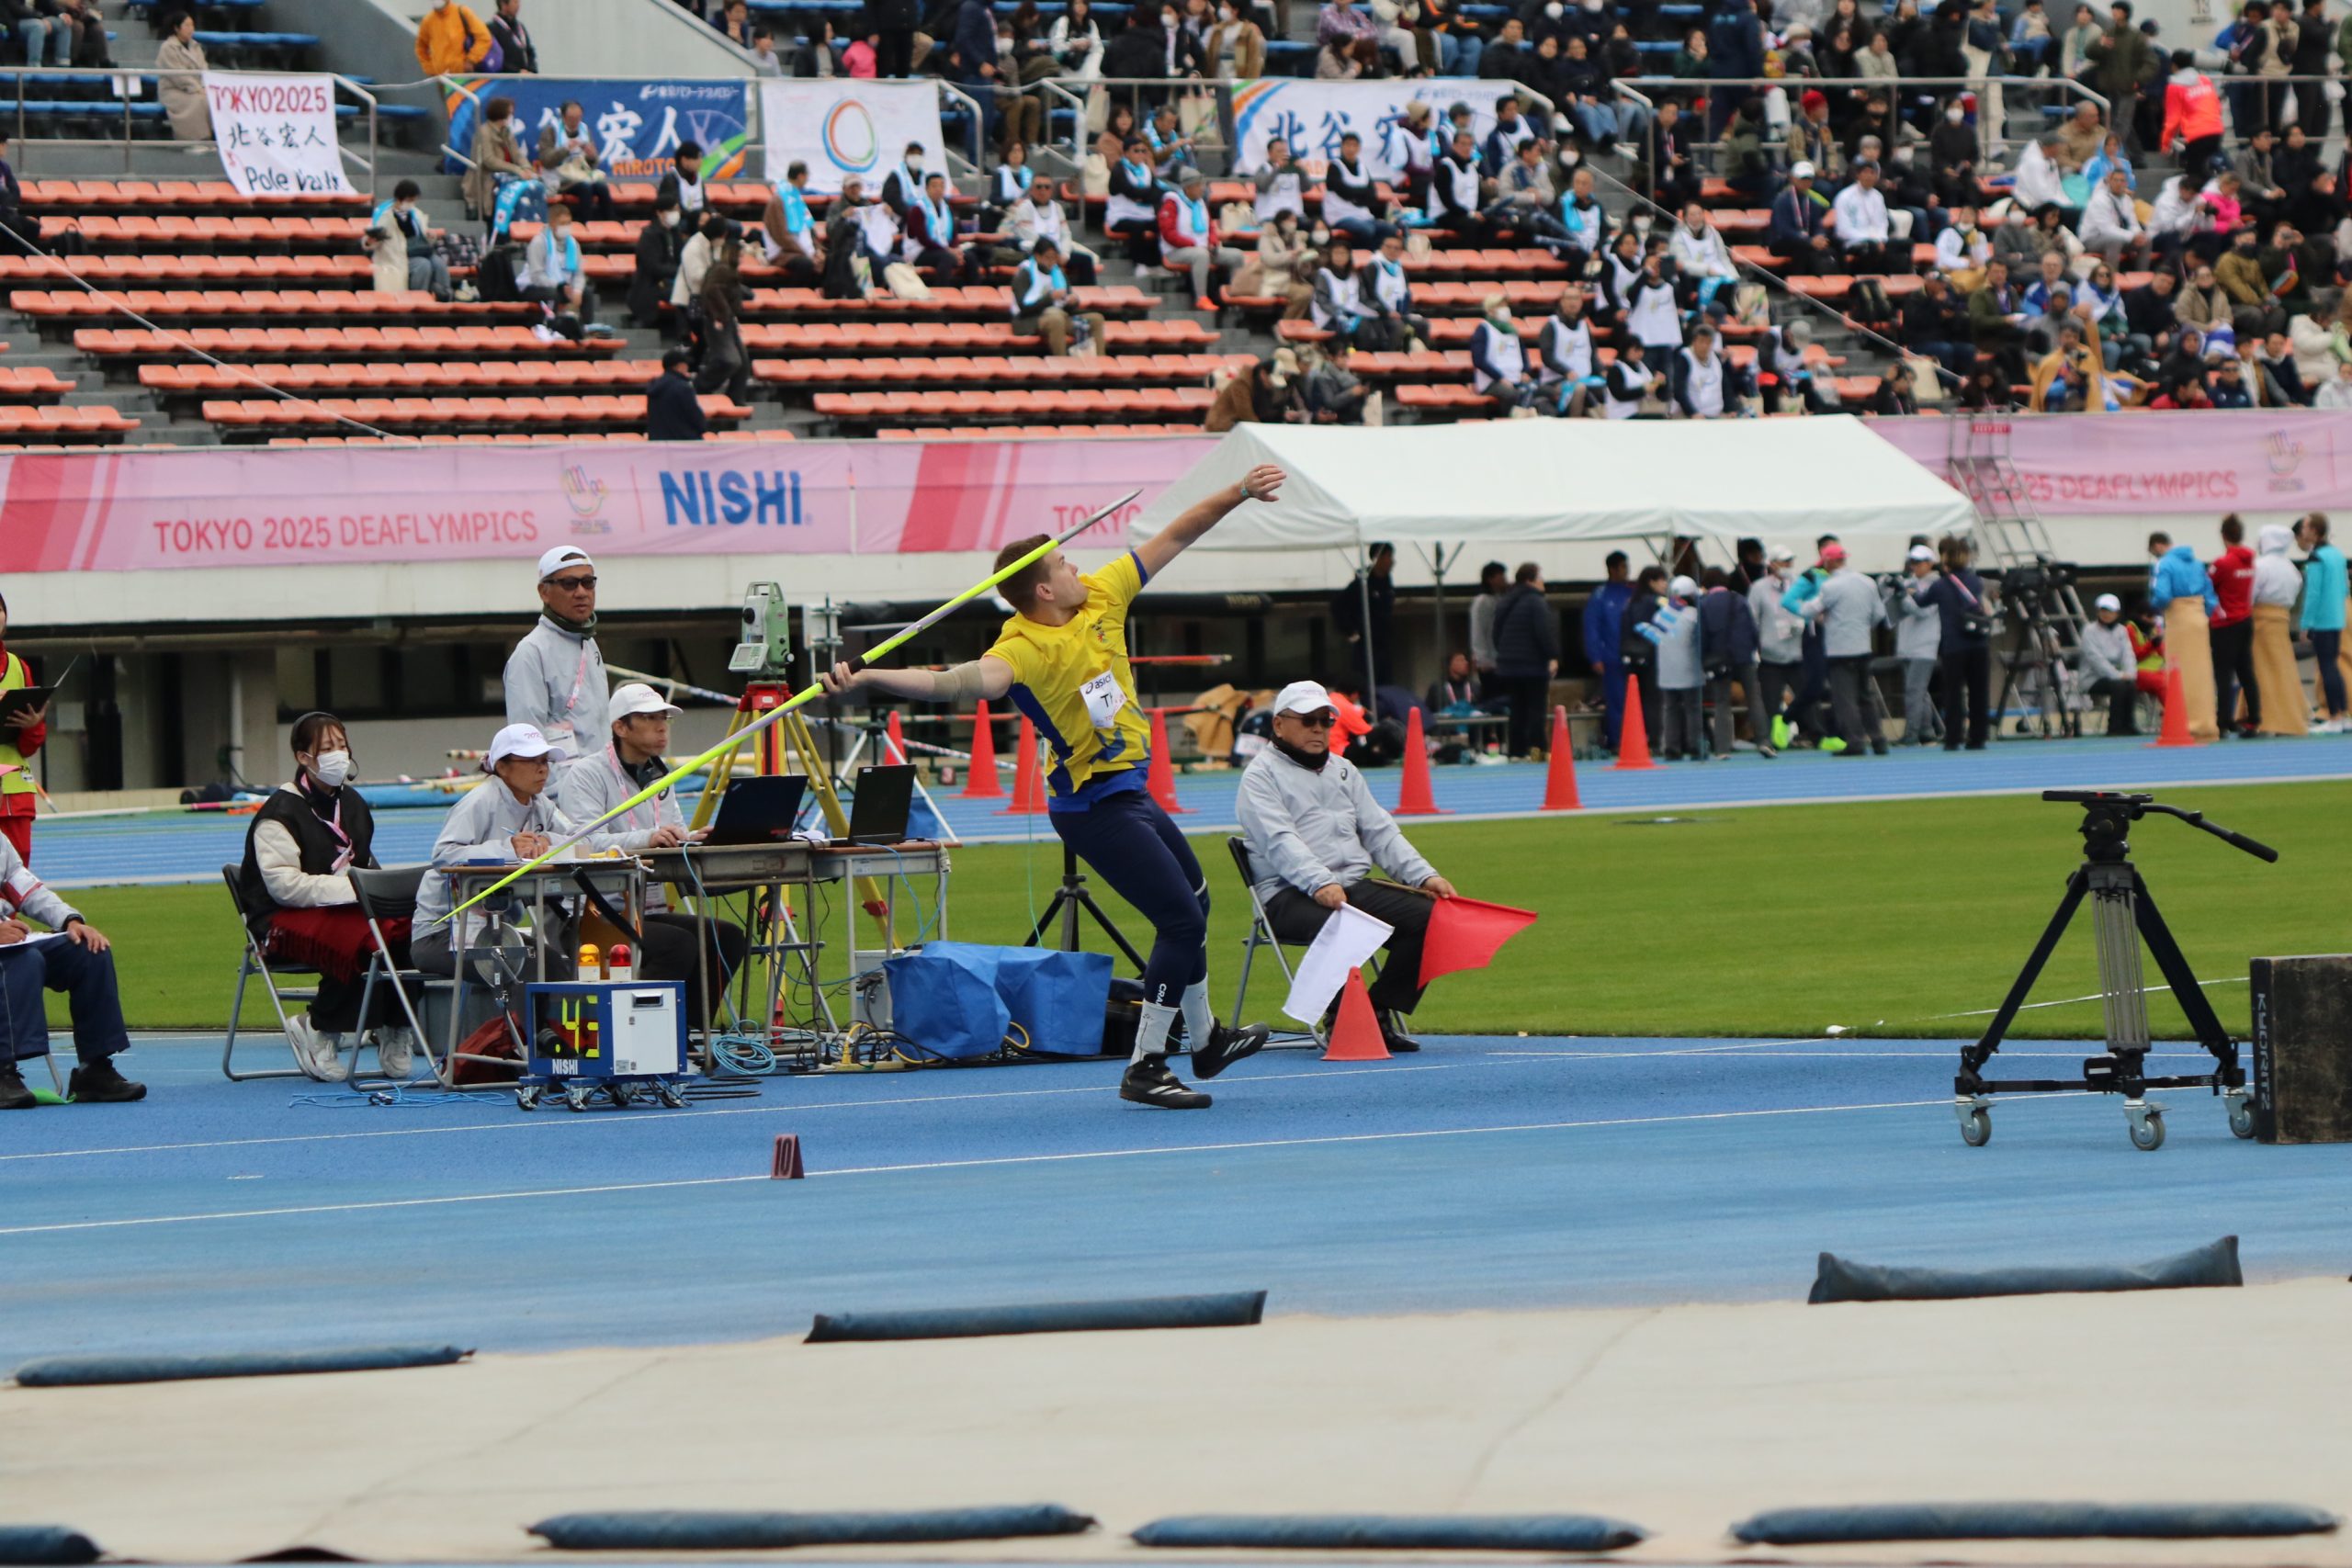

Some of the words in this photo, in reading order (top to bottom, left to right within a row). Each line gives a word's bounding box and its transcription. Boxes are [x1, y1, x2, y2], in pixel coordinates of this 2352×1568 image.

[229, 121, 327, 149] 北谷宏人
[245, 165, 289, 191] Pole
[659, 470, 802, 525] NISHI
[2060, 470, 2240, 502] DEAFLYMPICS
[153, 519, 253, 553] TOKYO
[264, 515, 332, 549] 2025
[339, 511, 539, 547] DEAFLYMPICS
[552, 1059, 579, 1076] NISHI
[774, 1137, 793, 1177] 10
